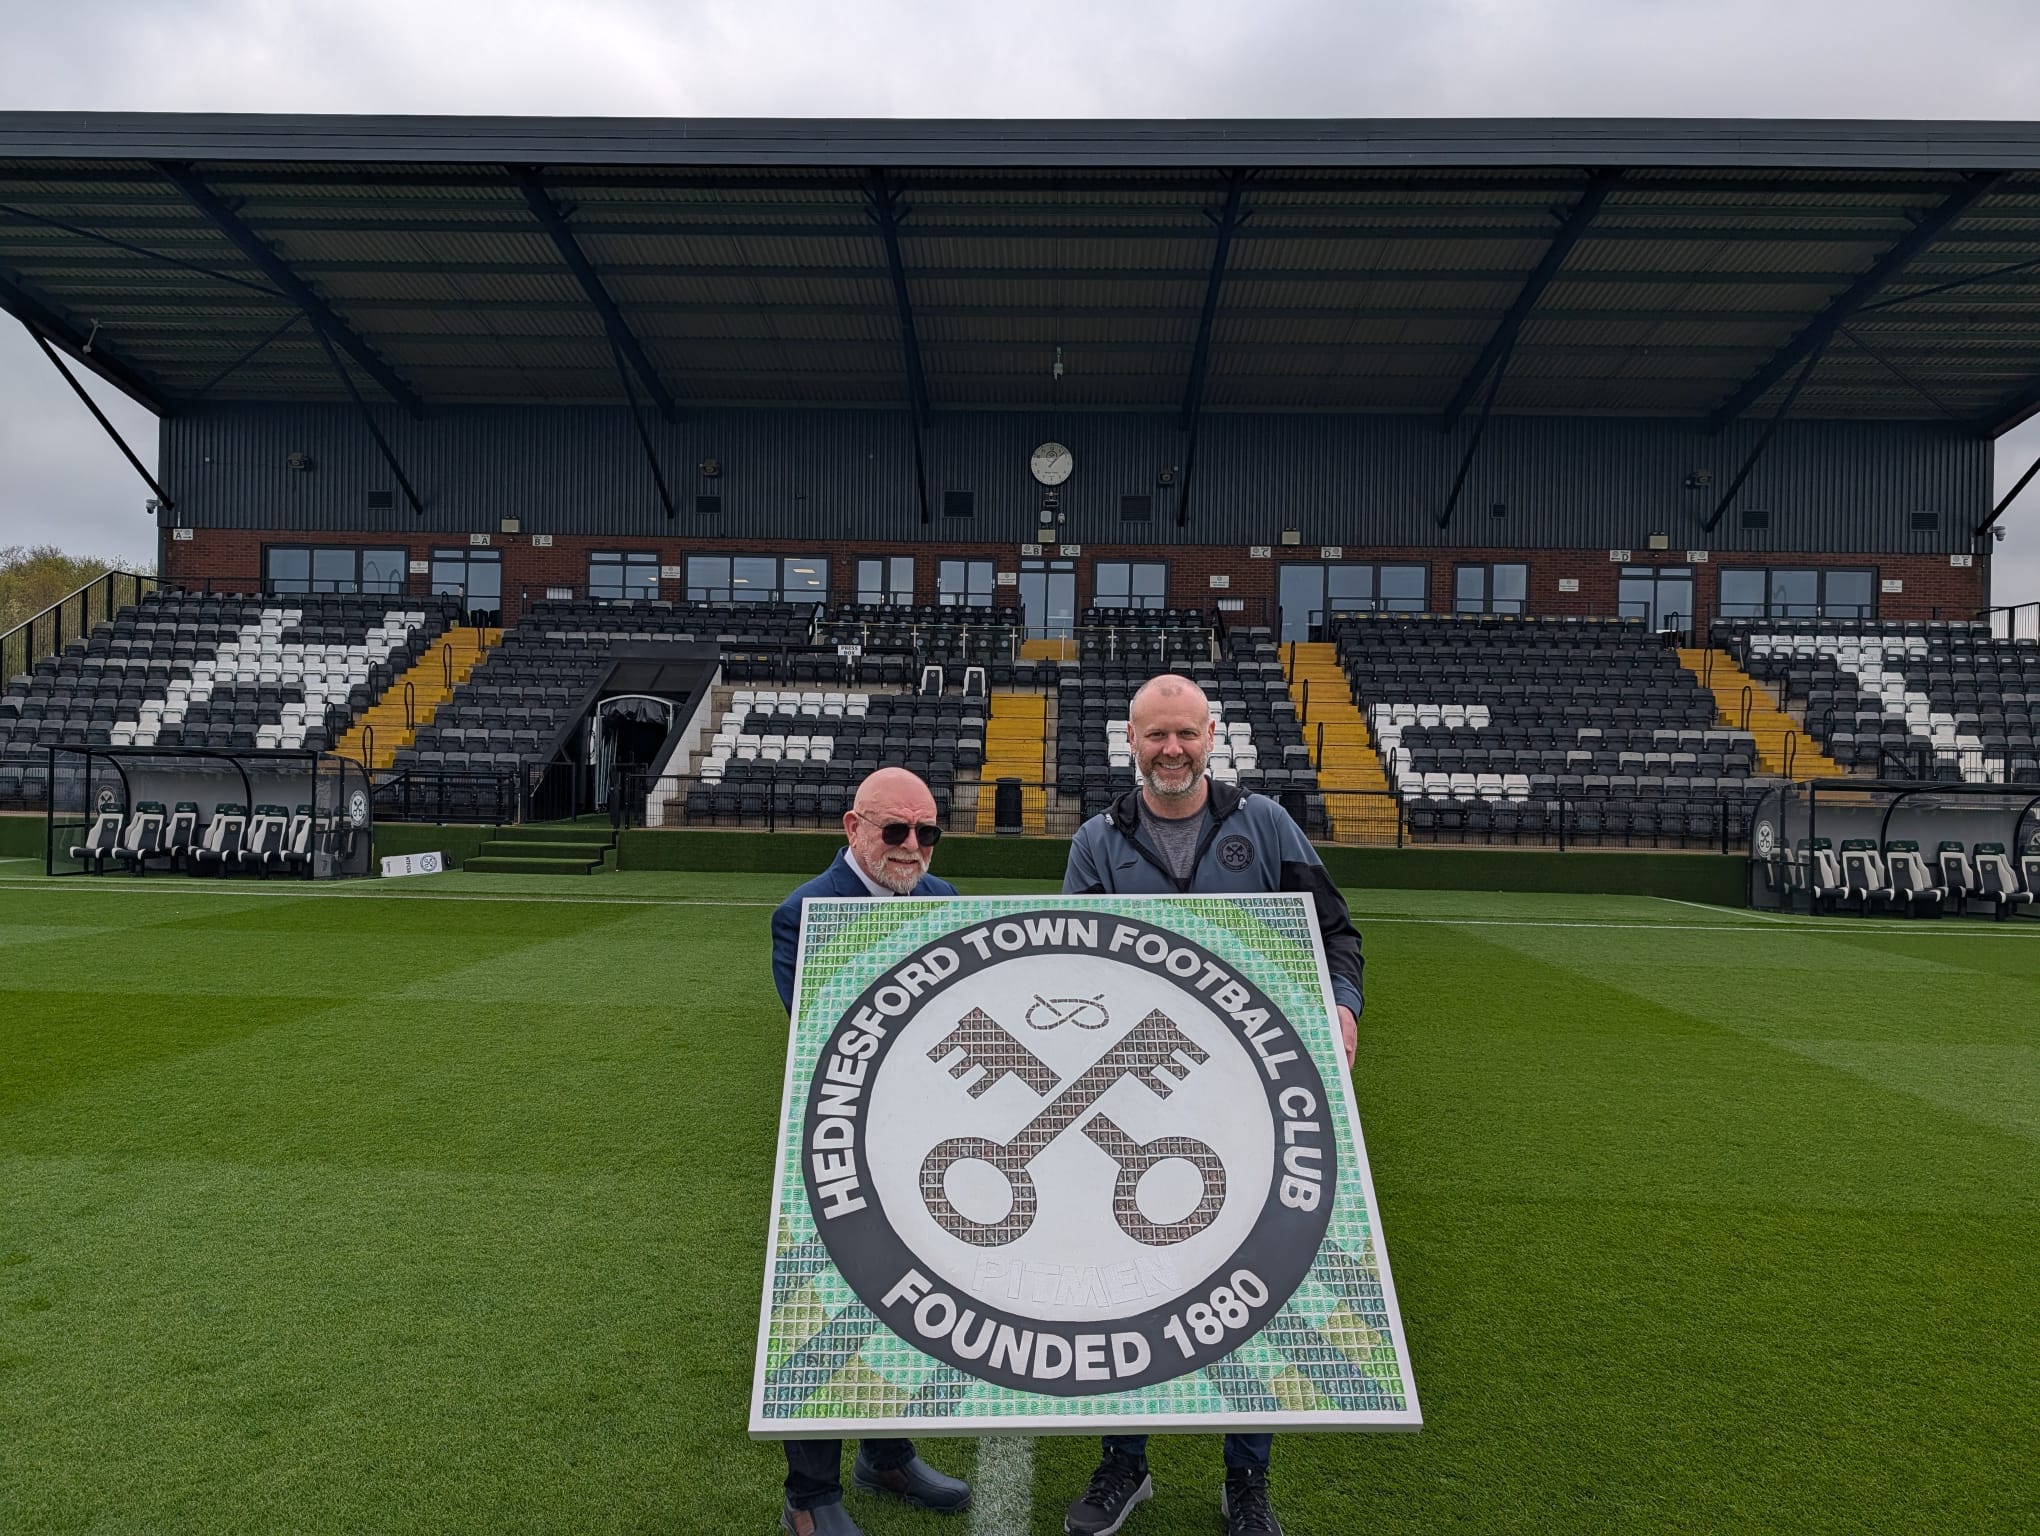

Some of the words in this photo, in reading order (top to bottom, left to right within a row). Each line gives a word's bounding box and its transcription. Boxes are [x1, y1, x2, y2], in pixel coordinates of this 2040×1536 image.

[811, 947, 960, 1220] HEDNESFORD
[961, 917, 1098, 961] TOWN
[1108, 923, 1299, 1082] FOOTBALL
[1279, 1086, 1322, 1212] CLUB
[880, 1268, 1151, 1381] FOUNDED
[1163, 1269, 1269, 1359] 1880
[972, 1251, 1183, 1308] PITMEN
